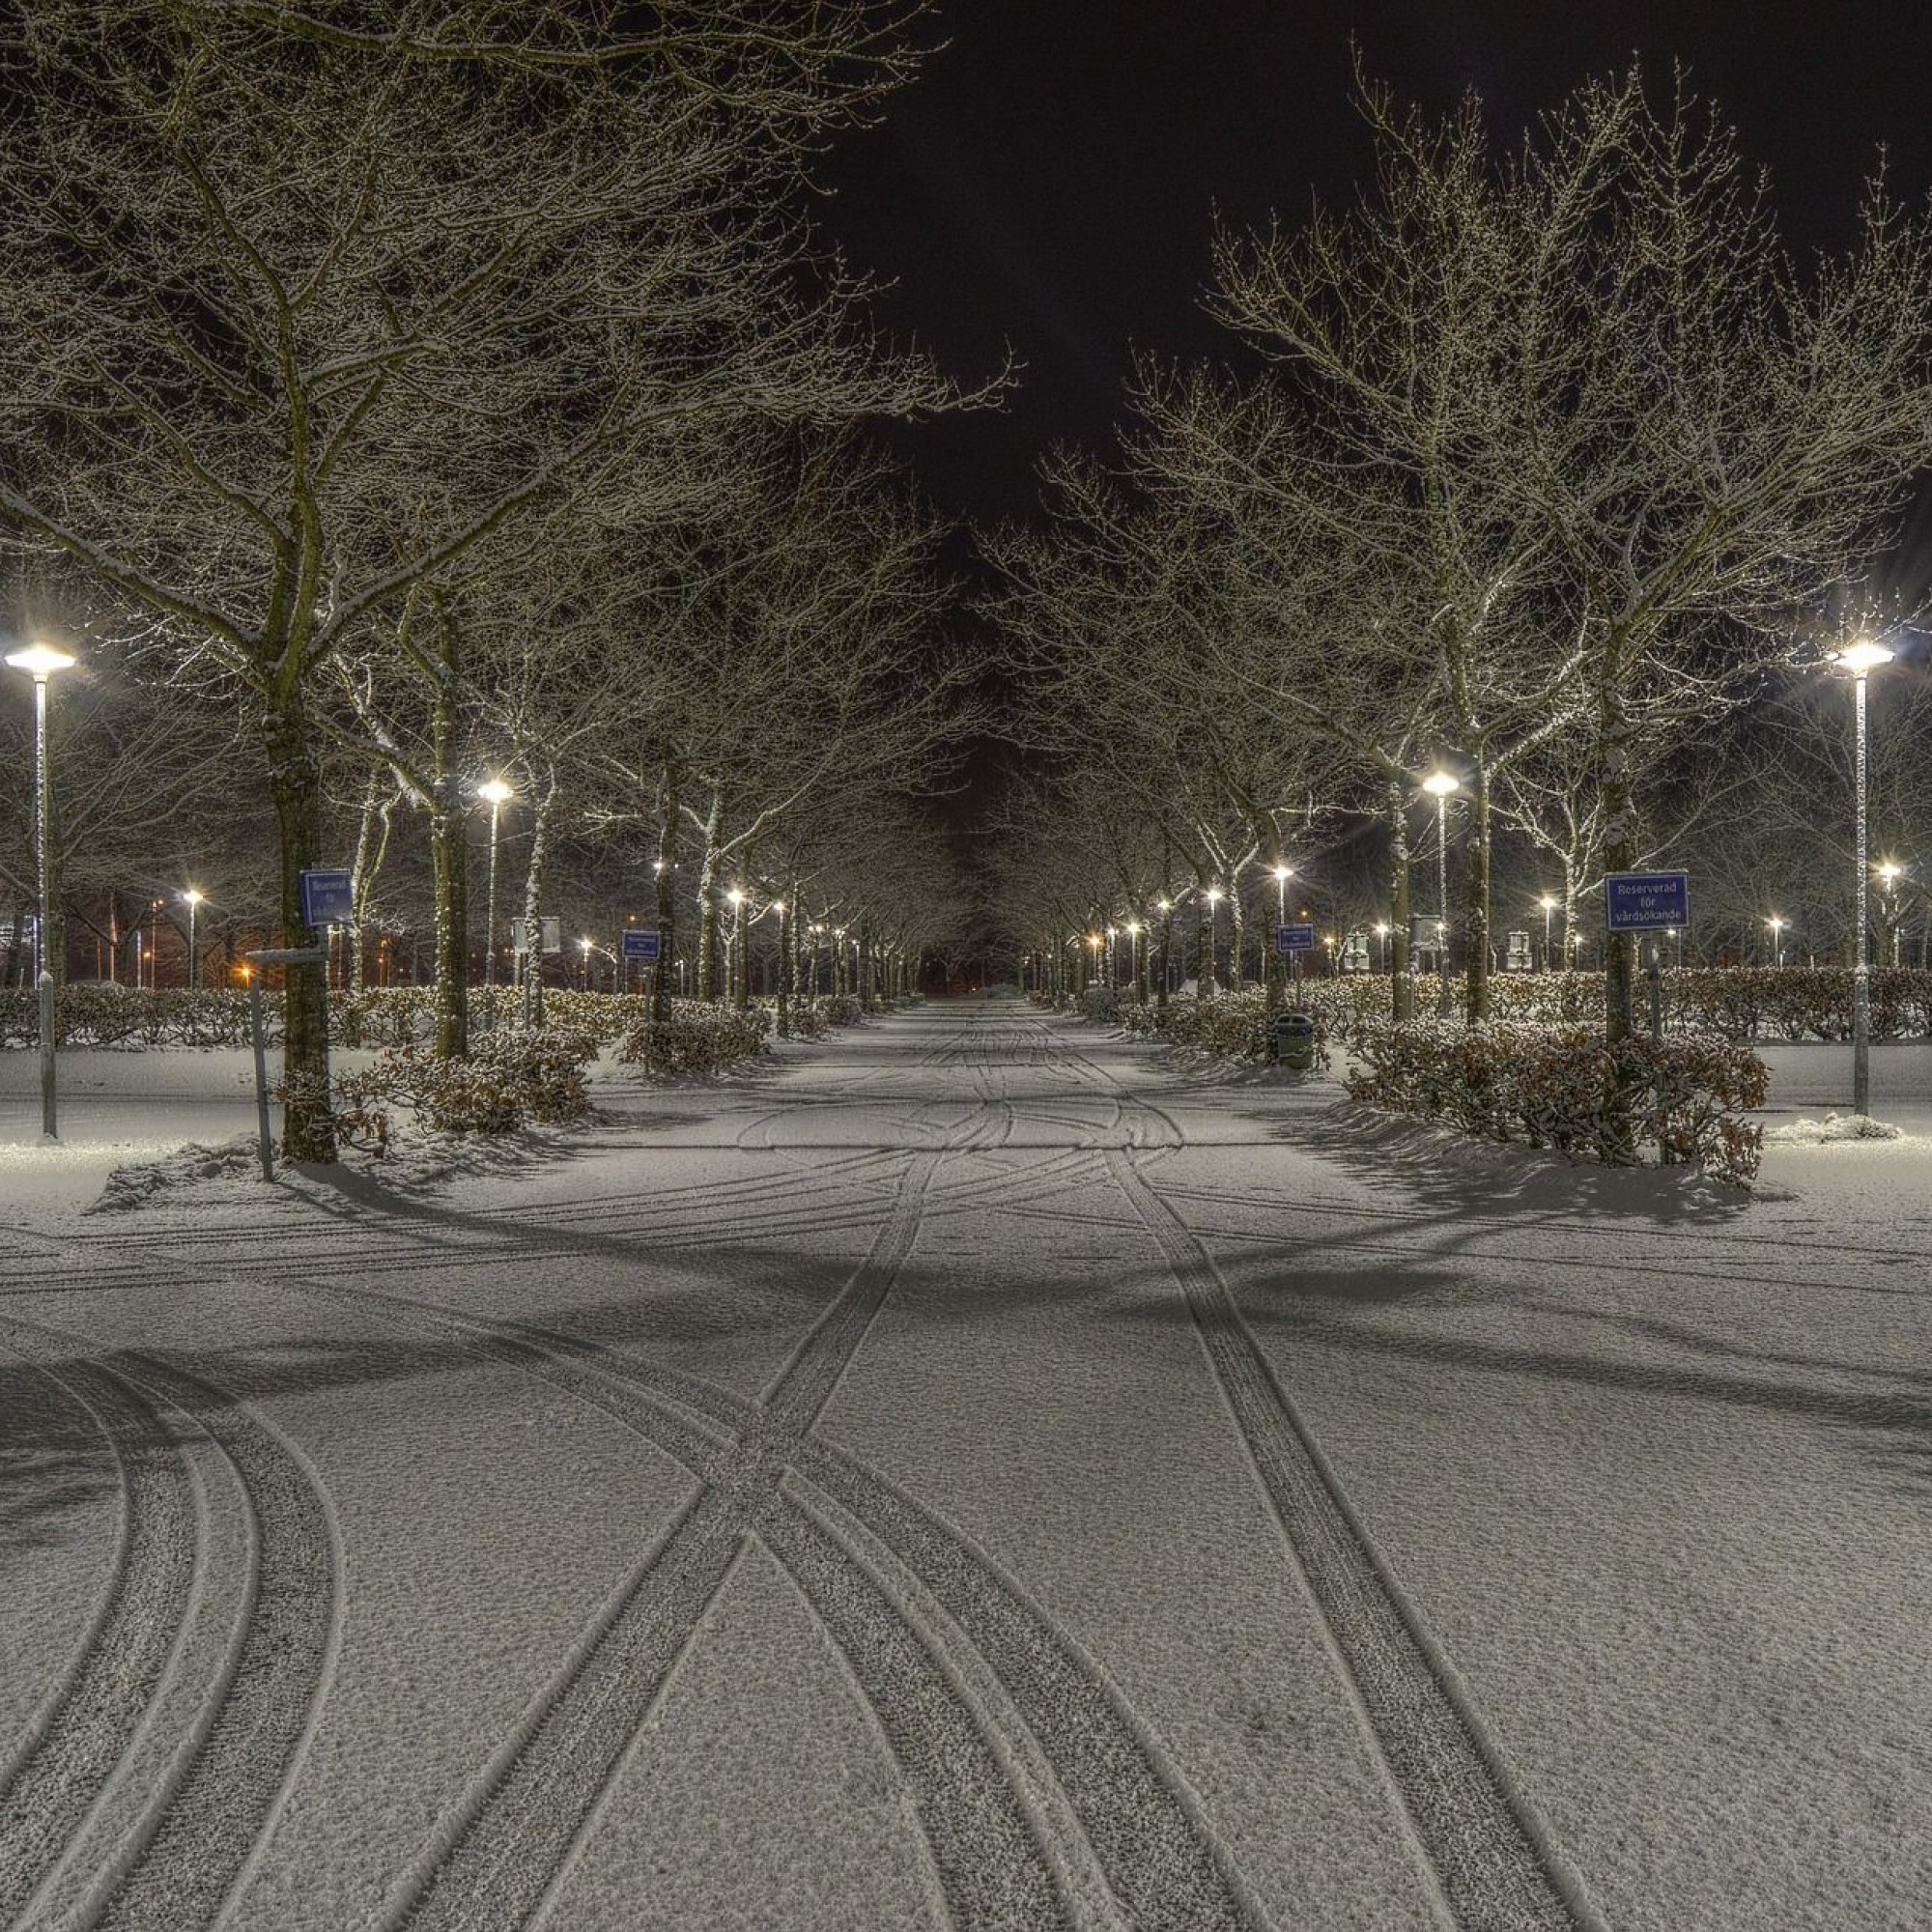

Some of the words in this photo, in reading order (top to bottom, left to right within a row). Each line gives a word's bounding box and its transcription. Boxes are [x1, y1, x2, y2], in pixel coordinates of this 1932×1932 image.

[1617, 881, 1677, 895] Reserverad
[1640, 896, 1656, 908] för
[1615, 908, 1682, 922] vårdsökande
